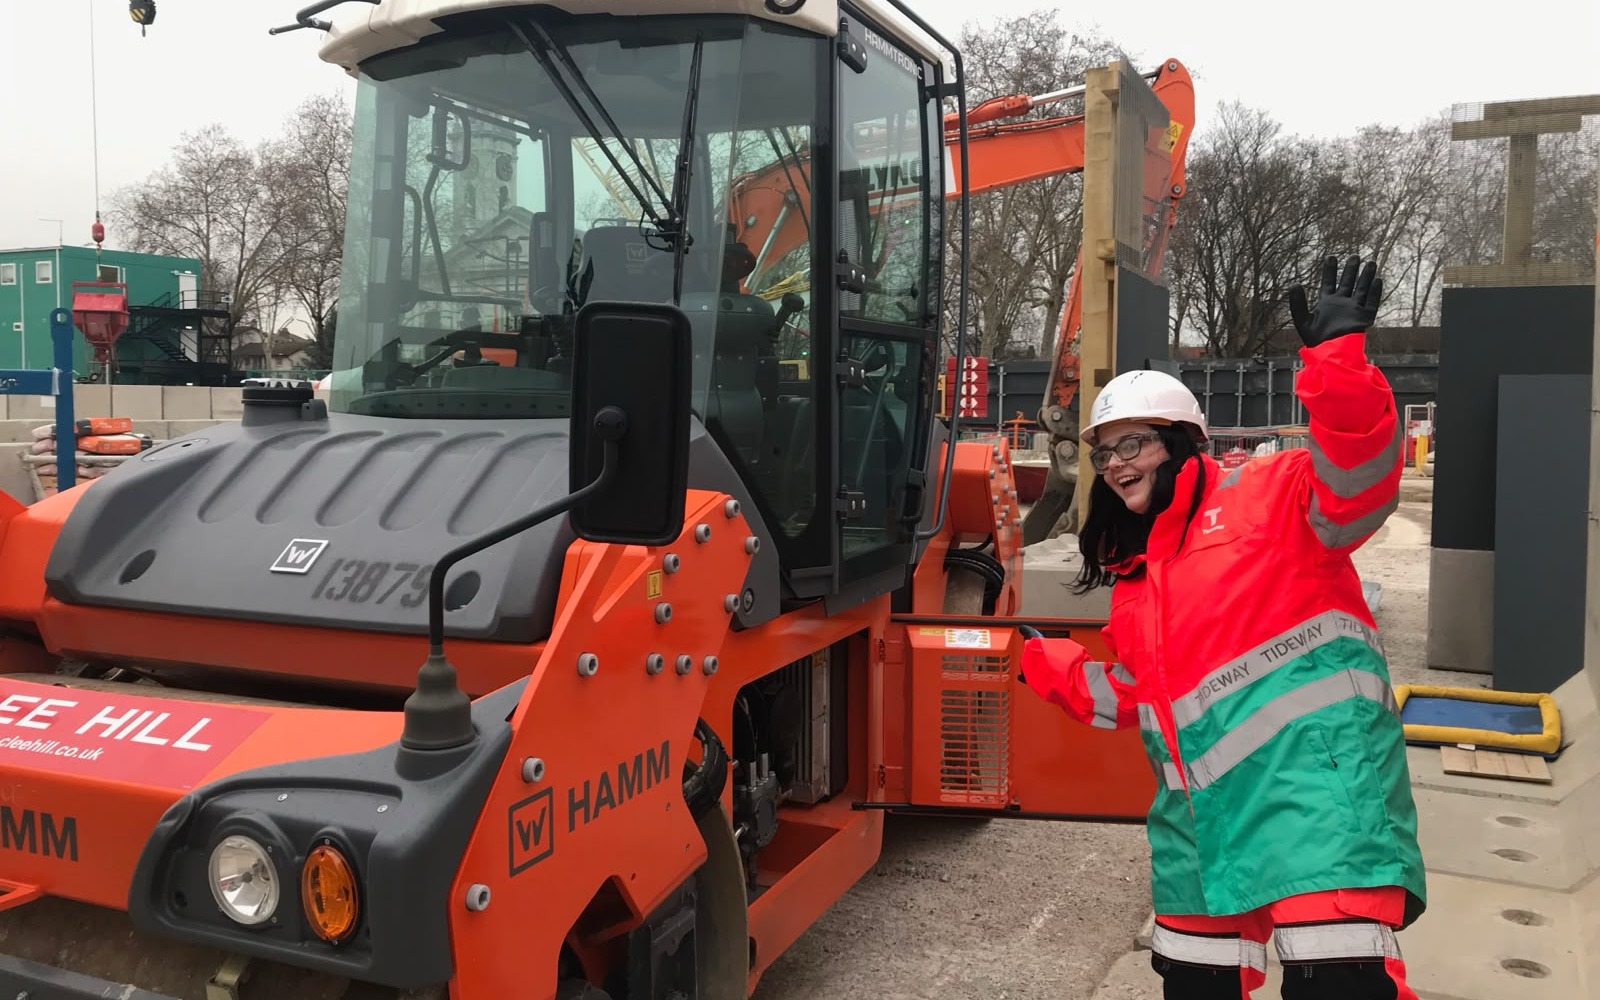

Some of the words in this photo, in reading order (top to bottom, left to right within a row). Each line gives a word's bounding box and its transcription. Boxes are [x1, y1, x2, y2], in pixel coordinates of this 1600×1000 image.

[864, 28, 923, 80] HAMMTRONIC
[1194, 661, 1250, 704] TIDEWAY
[1259, 622, 1324, 664] TIDEWAY
[74, 705, 212, 752] HILL
[568, 740, 670, 833] HAMM
[0, 805, 79, 862] MM
